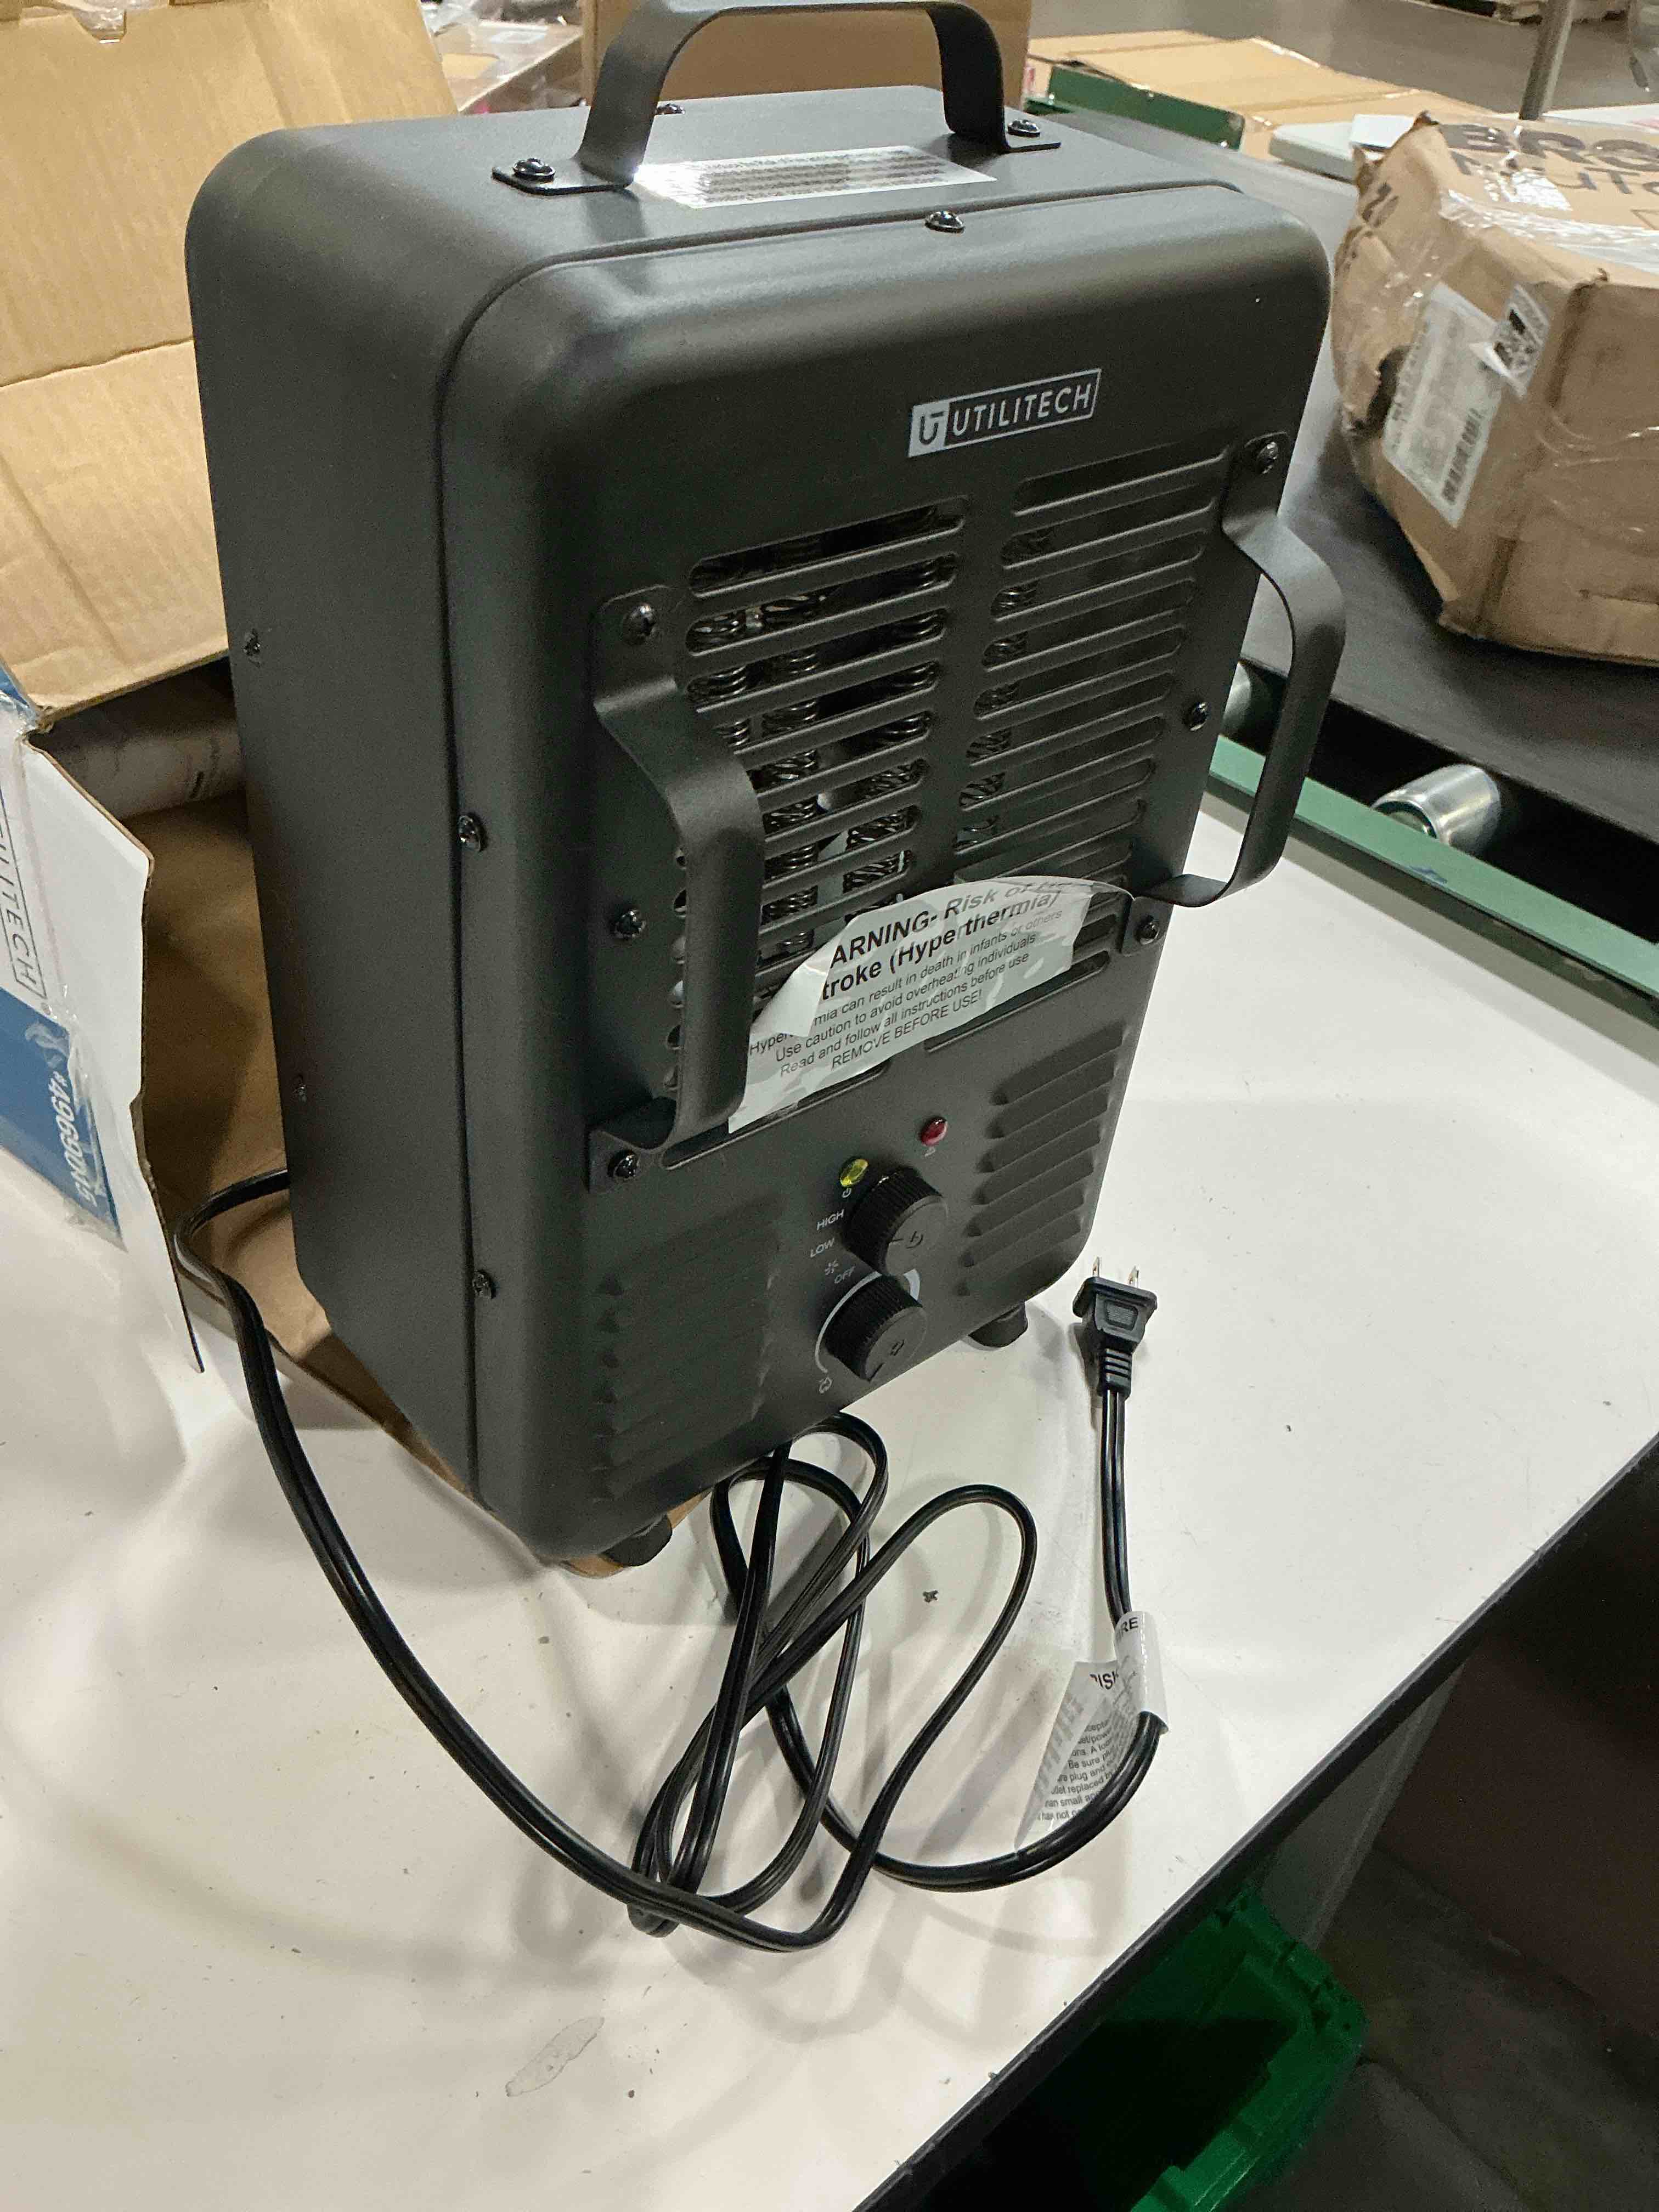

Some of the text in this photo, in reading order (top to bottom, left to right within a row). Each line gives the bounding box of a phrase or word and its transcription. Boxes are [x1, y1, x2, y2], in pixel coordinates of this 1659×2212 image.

[953, 383, 1091, 436] UTILITECH
[944, 889, 998, 919] Risk
[841, 997, 865, 1014] can
[869, 982, 902, 1001] result
[905, 972, 916, 984] in
[921, 955, 953, 978] death
[957, 951, 967, 962] in
[970, 933, 1007, 956] infants
[1025, 911, 1063, 930] others
[776, 933, 1036, 1062] Use caution to avoid overheating individuals
[781, 953, 1029, 1075] Read and follow all instructions before use
[832, 989, 982, 1069] REMOVE BEFORE USE!
[810, 1238, 835, 1258] LOW
[816, 1209, 844, 1231] HIGH
